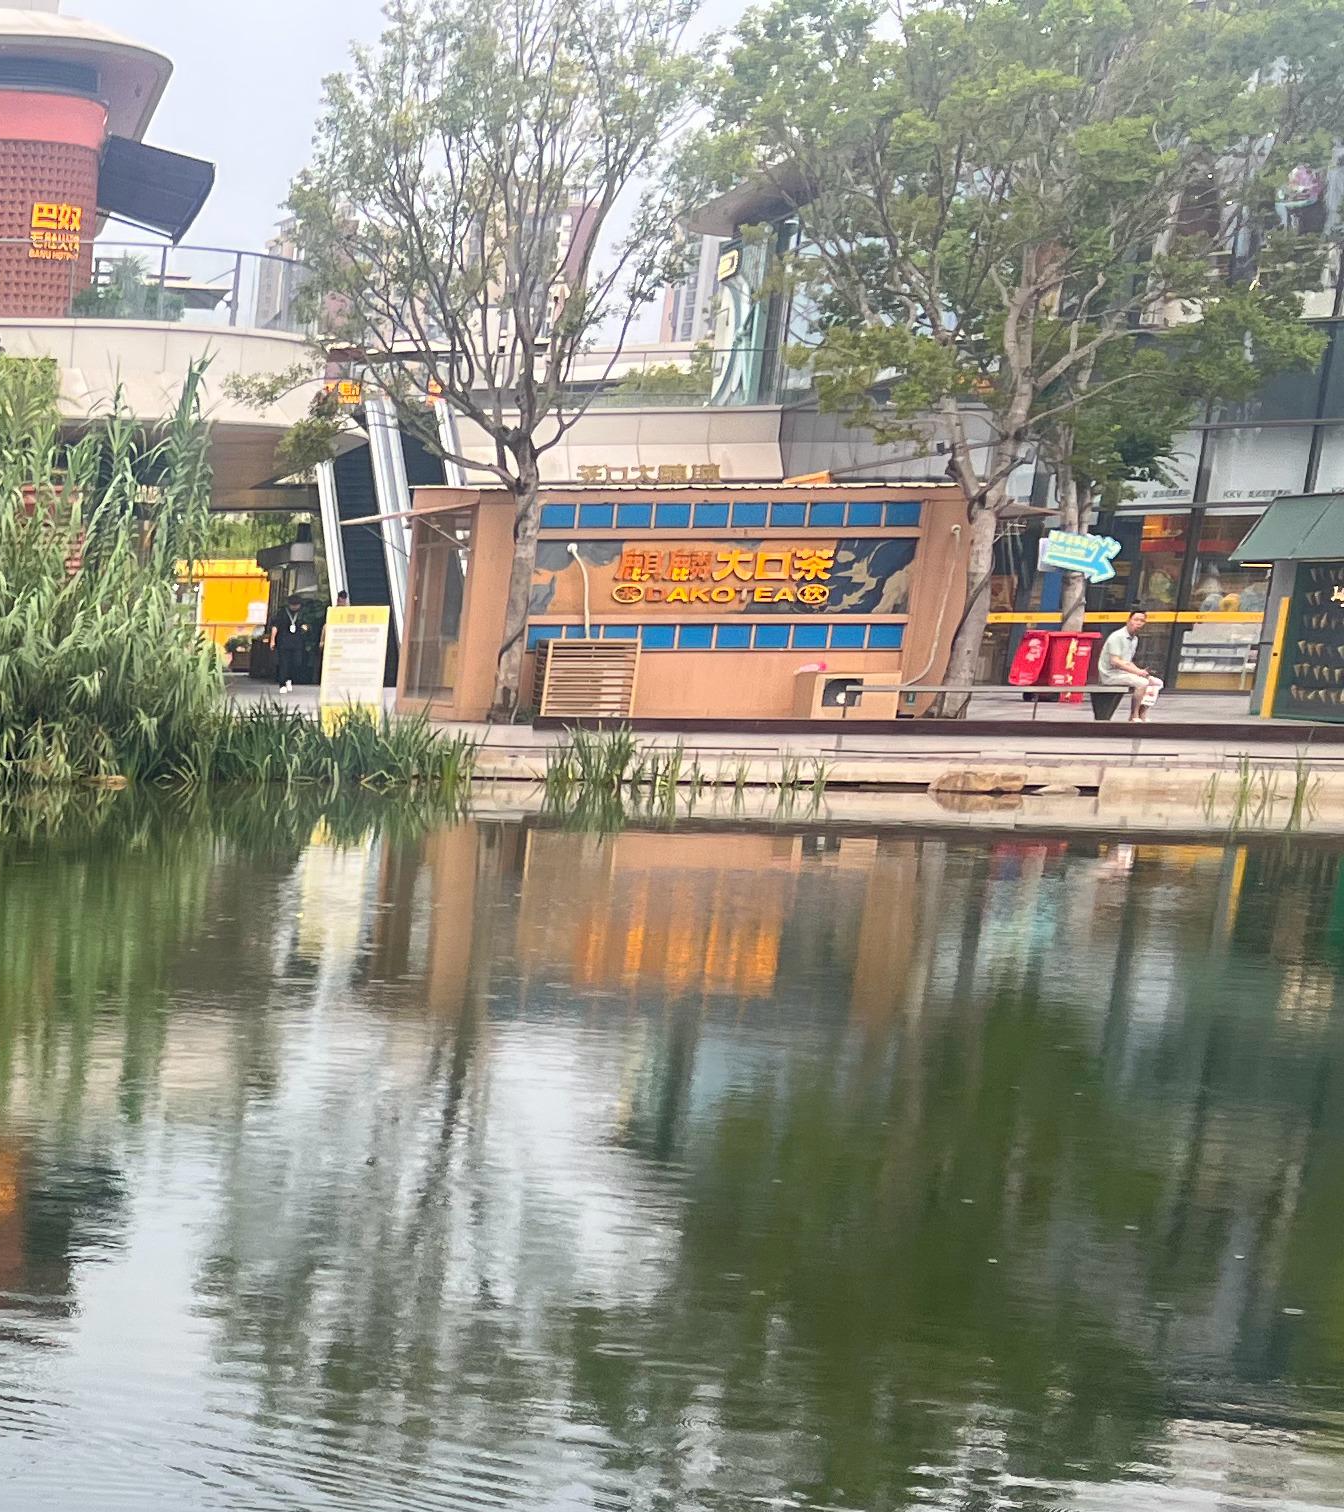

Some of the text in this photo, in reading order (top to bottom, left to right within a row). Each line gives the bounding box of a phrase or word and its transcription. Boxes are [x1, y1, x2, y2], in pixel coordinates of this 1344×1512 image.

[31, 202, 82, 231] 巴奴
[612, 547, 836, 583] 麒麟大口茶
